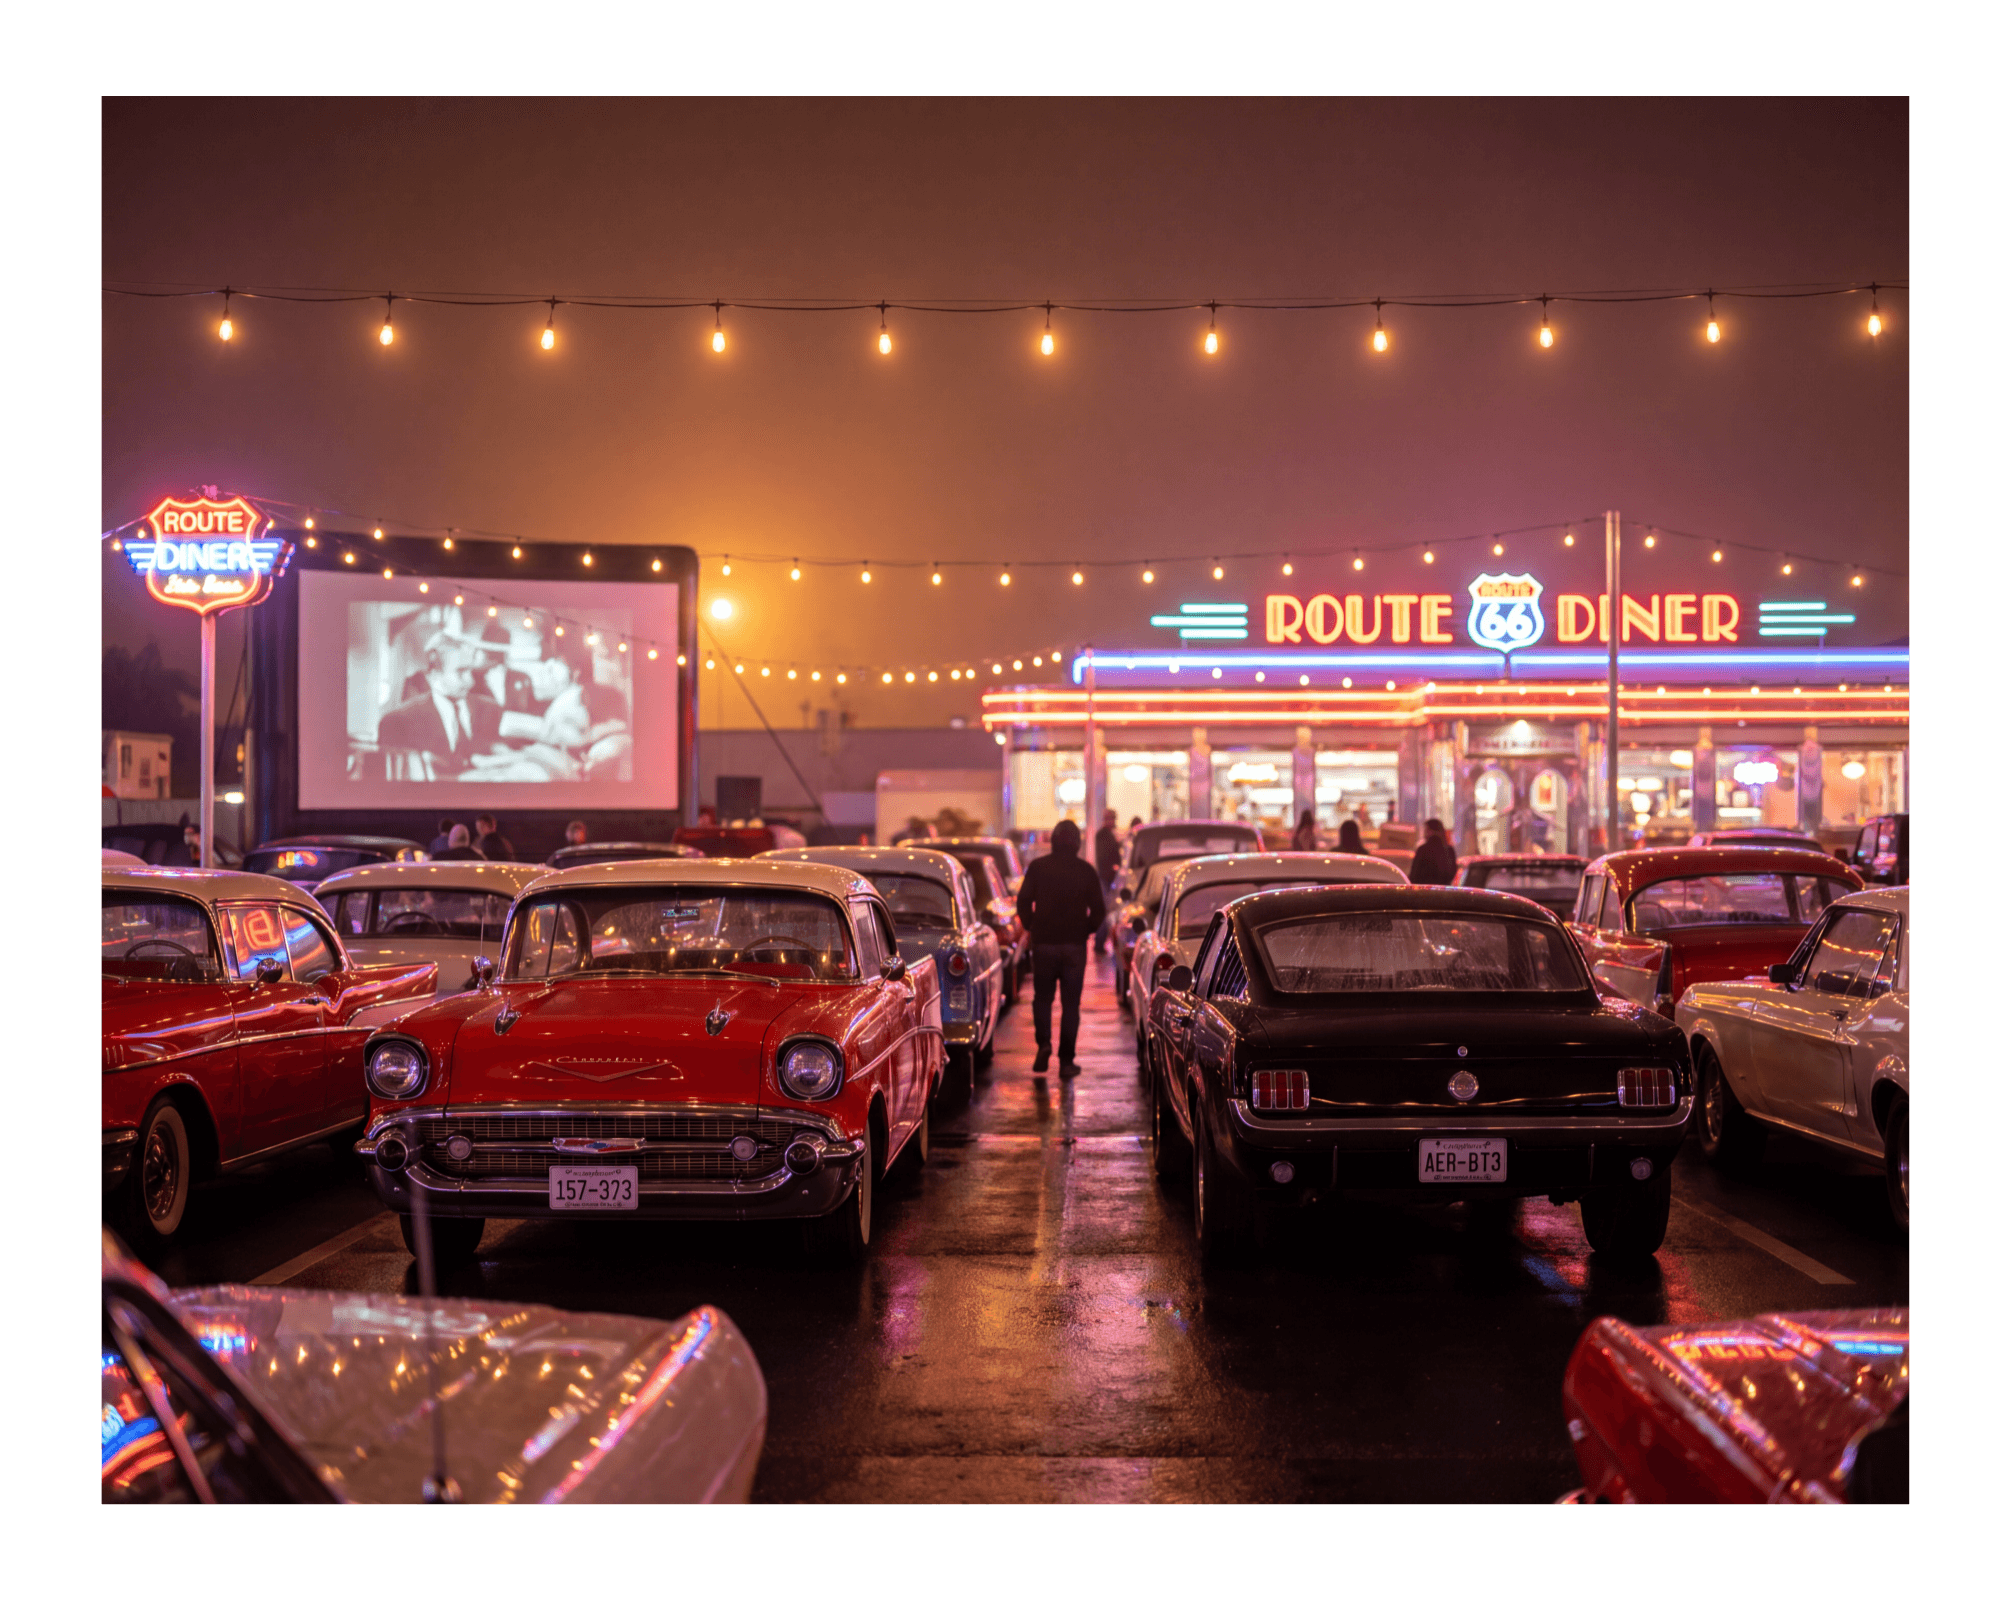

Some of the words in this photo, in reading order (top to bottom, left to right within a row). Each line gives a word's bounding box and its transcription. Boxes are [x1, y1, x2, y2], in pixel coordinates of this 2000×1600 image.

[164, 511, 243, 532] ROUTE
[157, 541, 249, 571] DINER
[1265, 593, 1453, 644] ROUTE
[1479, 602, 1534, 640] 66
[1557, 594, 1740, 643] DINER
[1424, 1151, 1501, 1173] AER-BT3
[555, 1179, 632, 1201] 157-373
